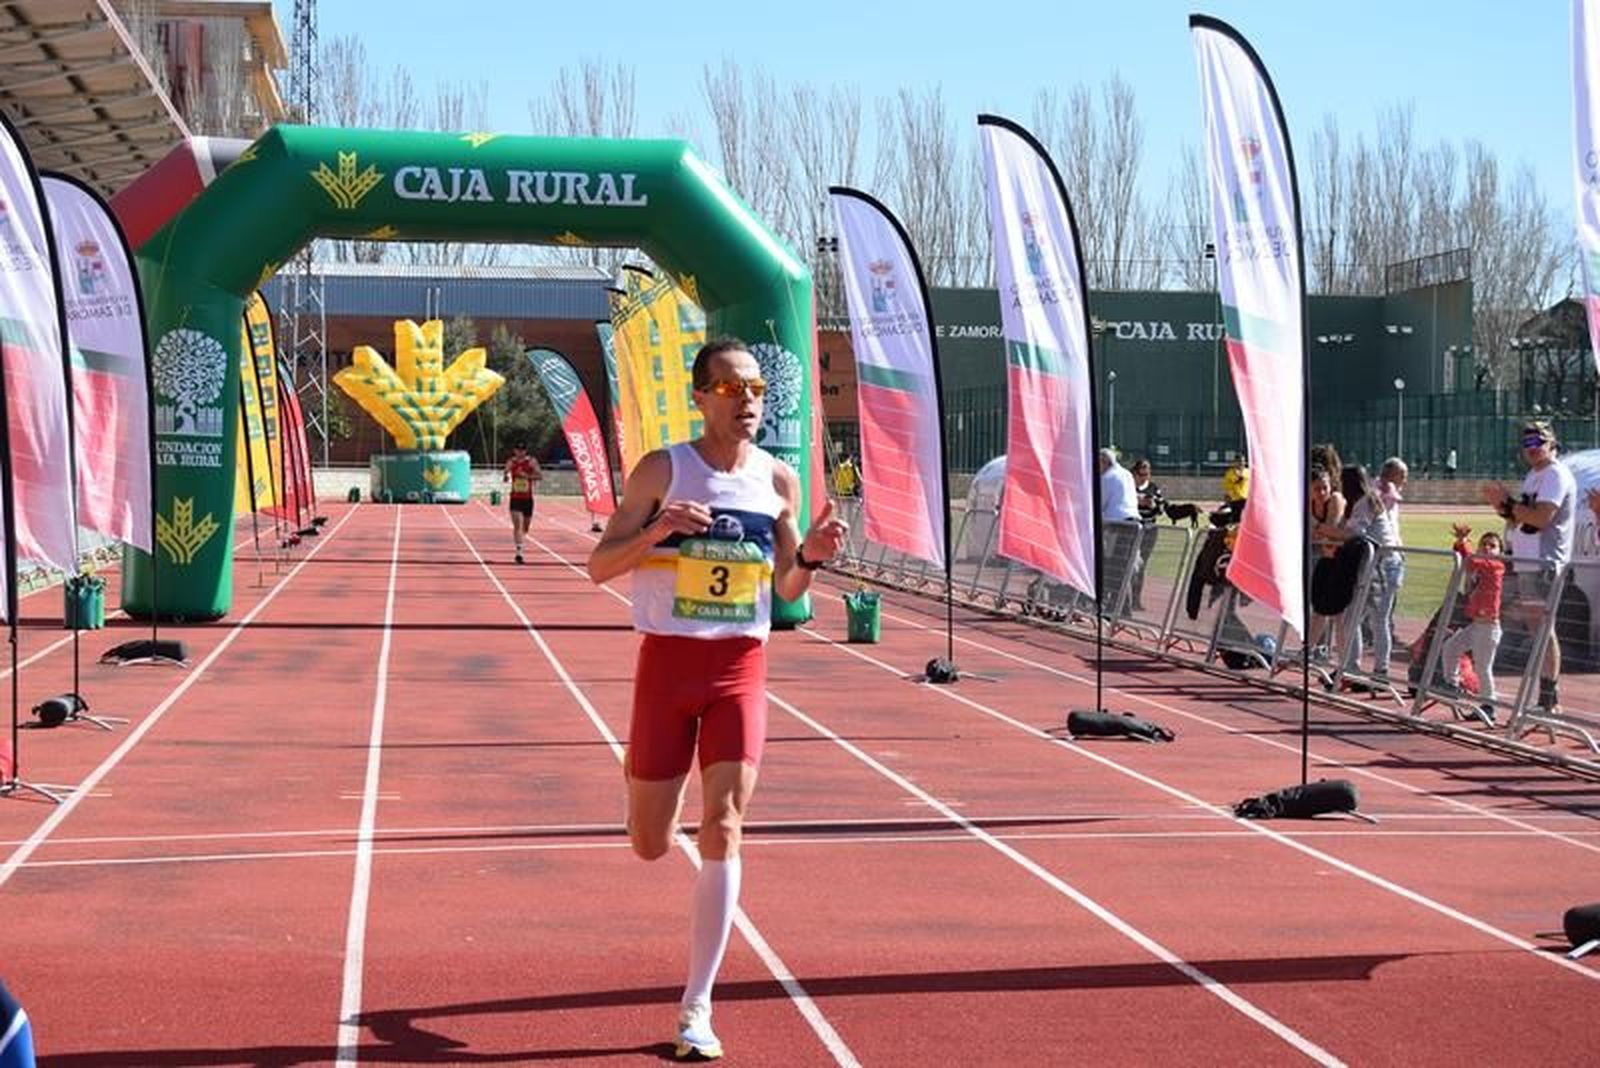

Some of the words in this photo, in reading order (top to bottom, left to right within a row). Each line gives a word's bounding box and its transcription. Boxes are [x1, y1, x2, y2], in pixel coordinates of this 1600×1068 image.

[394, 166, 494, 203] CAJA
[506, 169, 648, 207] RURAL
[935, 325, 945, 338] E
[1115, 321, 1177, 341] CAJA
[156, 441, 223, 455] UNDACION
[181, 454, 223, 468] RURAL
[709, 565, 730, 597] 3
